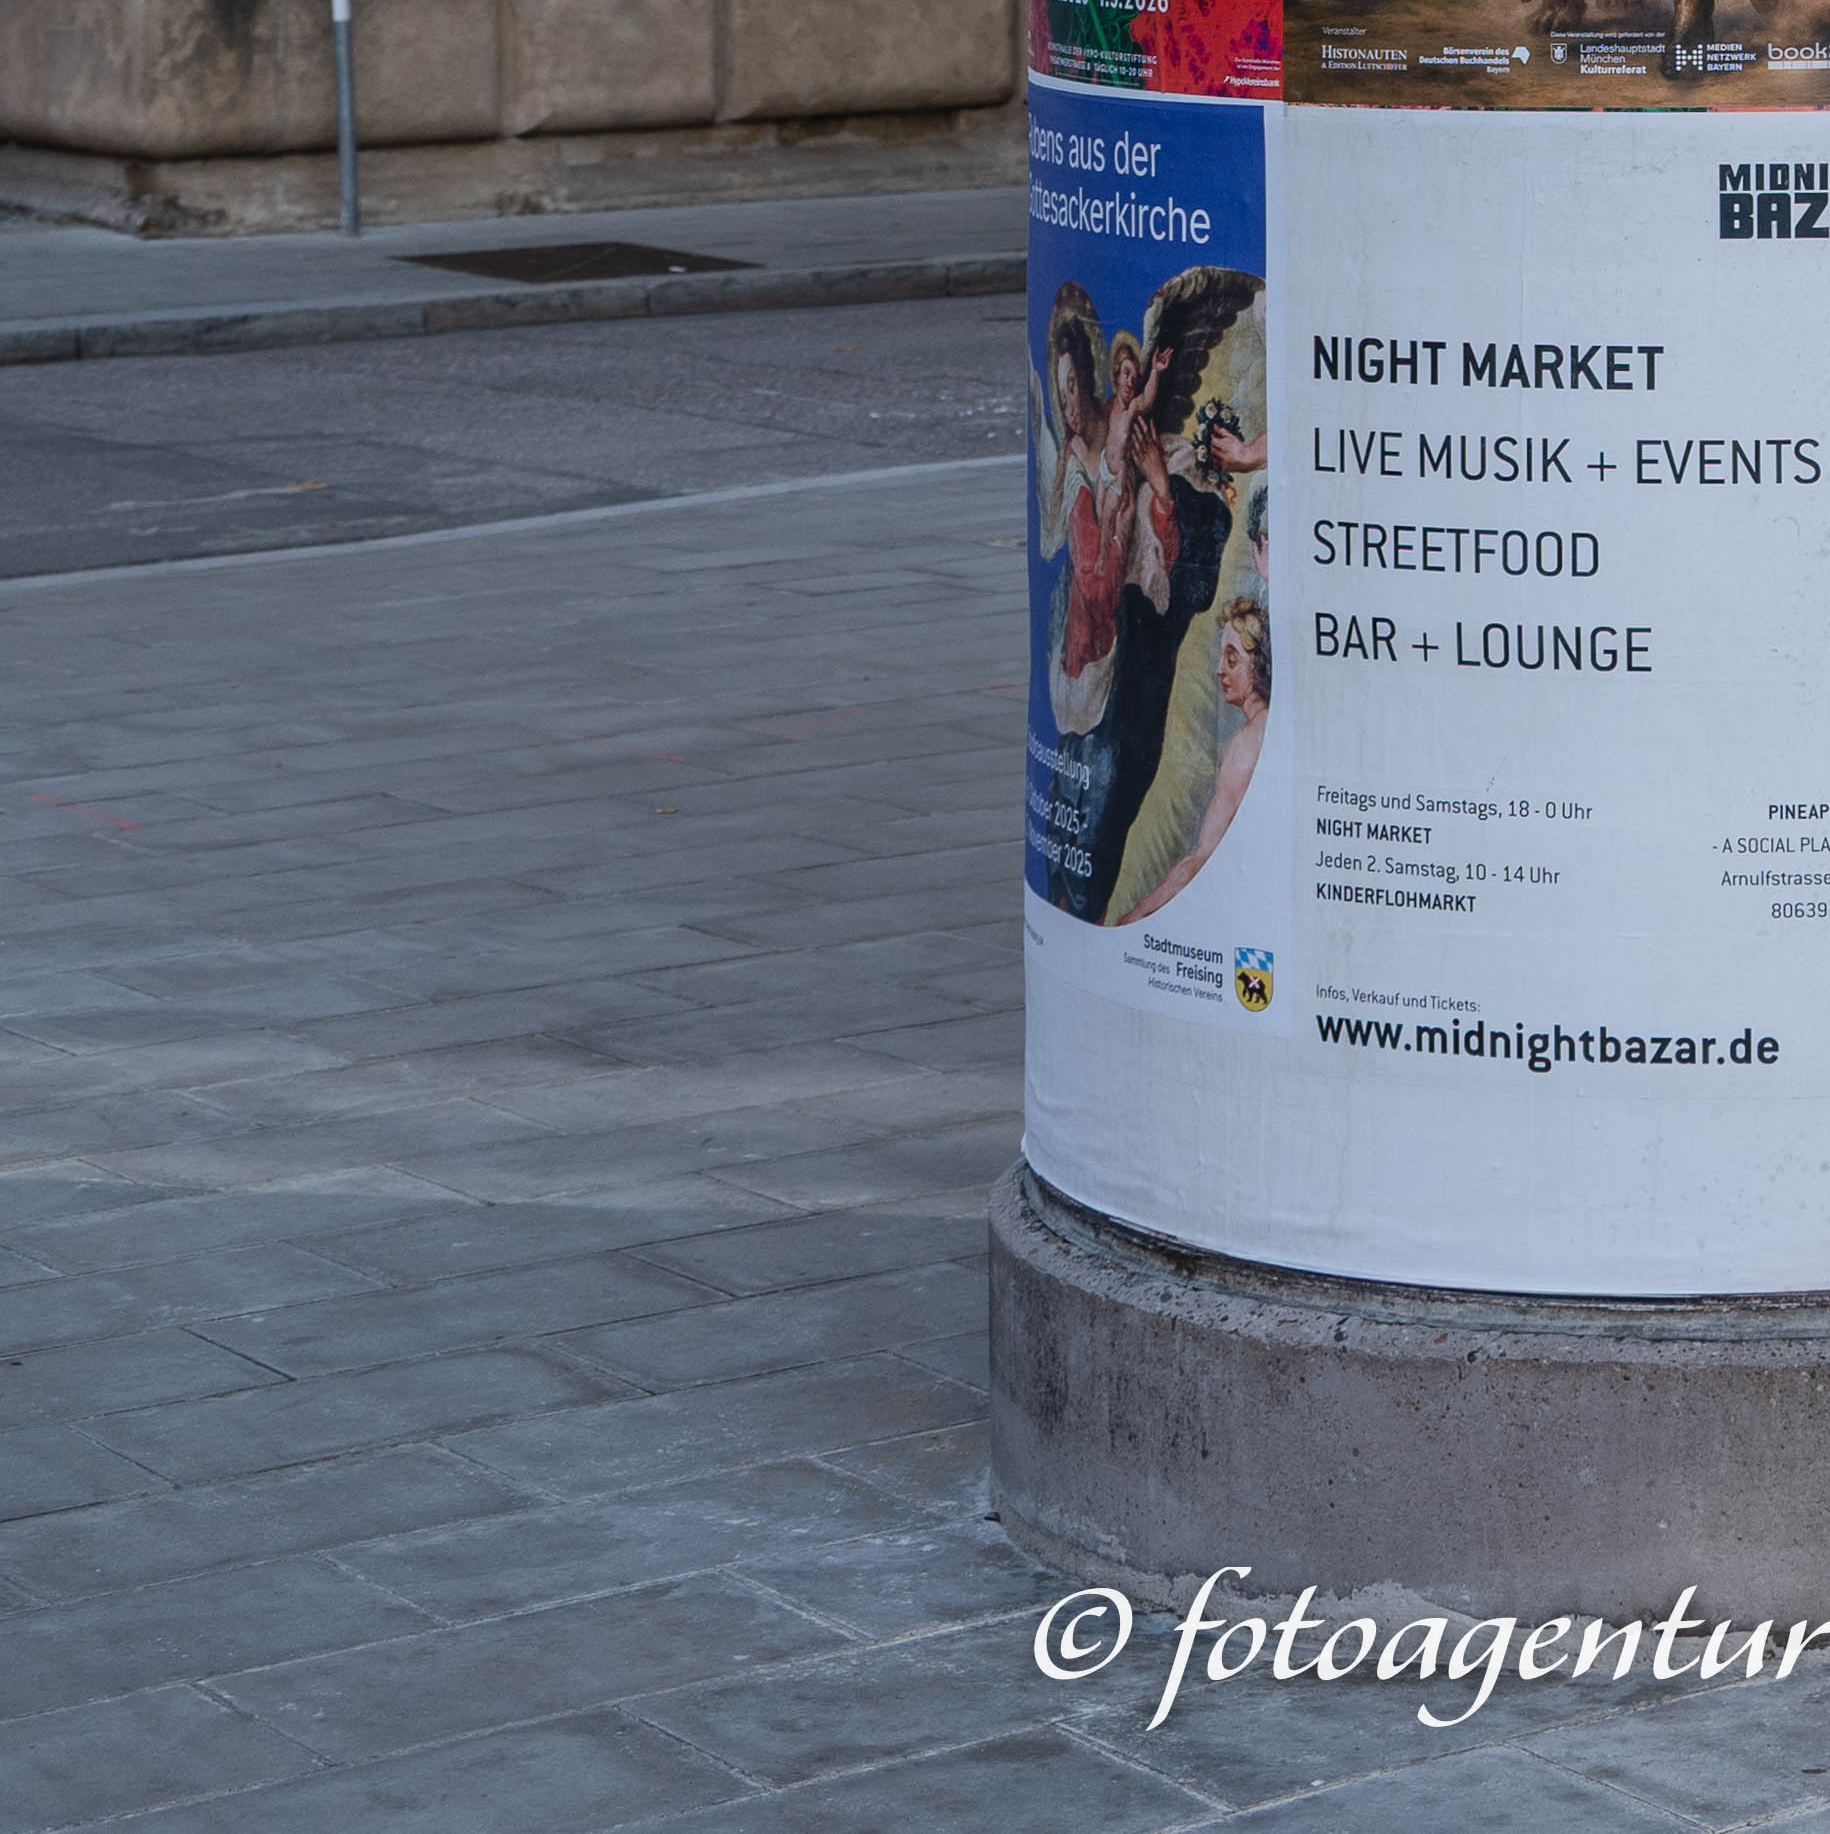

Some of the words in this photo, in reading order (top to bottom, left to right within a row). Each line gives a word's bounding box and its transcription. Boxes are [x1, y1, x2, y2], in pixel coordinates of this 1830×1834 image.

[1707, 44, 1743, 52] MEDIEN
[1707, 53, 1757, 61] NETZWERK
[1707, 63, 1742, 71] BAYERN
[1069, 134, 1105, 171] aus
[1114, 131, 1161, 177] der
[1313, 335, 1446, 384] NIGHT
[1462, 341, 1664, 390] MARKET
[1313, 519, 1599, 577] STREETFOOD
[1314, 613, 1398, 662] BAR
[1412, 632, 1439, 662] +
[1456, 622, 1652, 672] LOUNGE
[1315, 883, 1476, 913] KINDERFLOHMARKT
[1771, 901, 1828, 919] 80639
[1144, 933, 1223, 964] Stadtmuseum
[1176, 961, 1223, 988] Freising
[1315, 1014, 1779, 1073] www.midnightbazar.de
